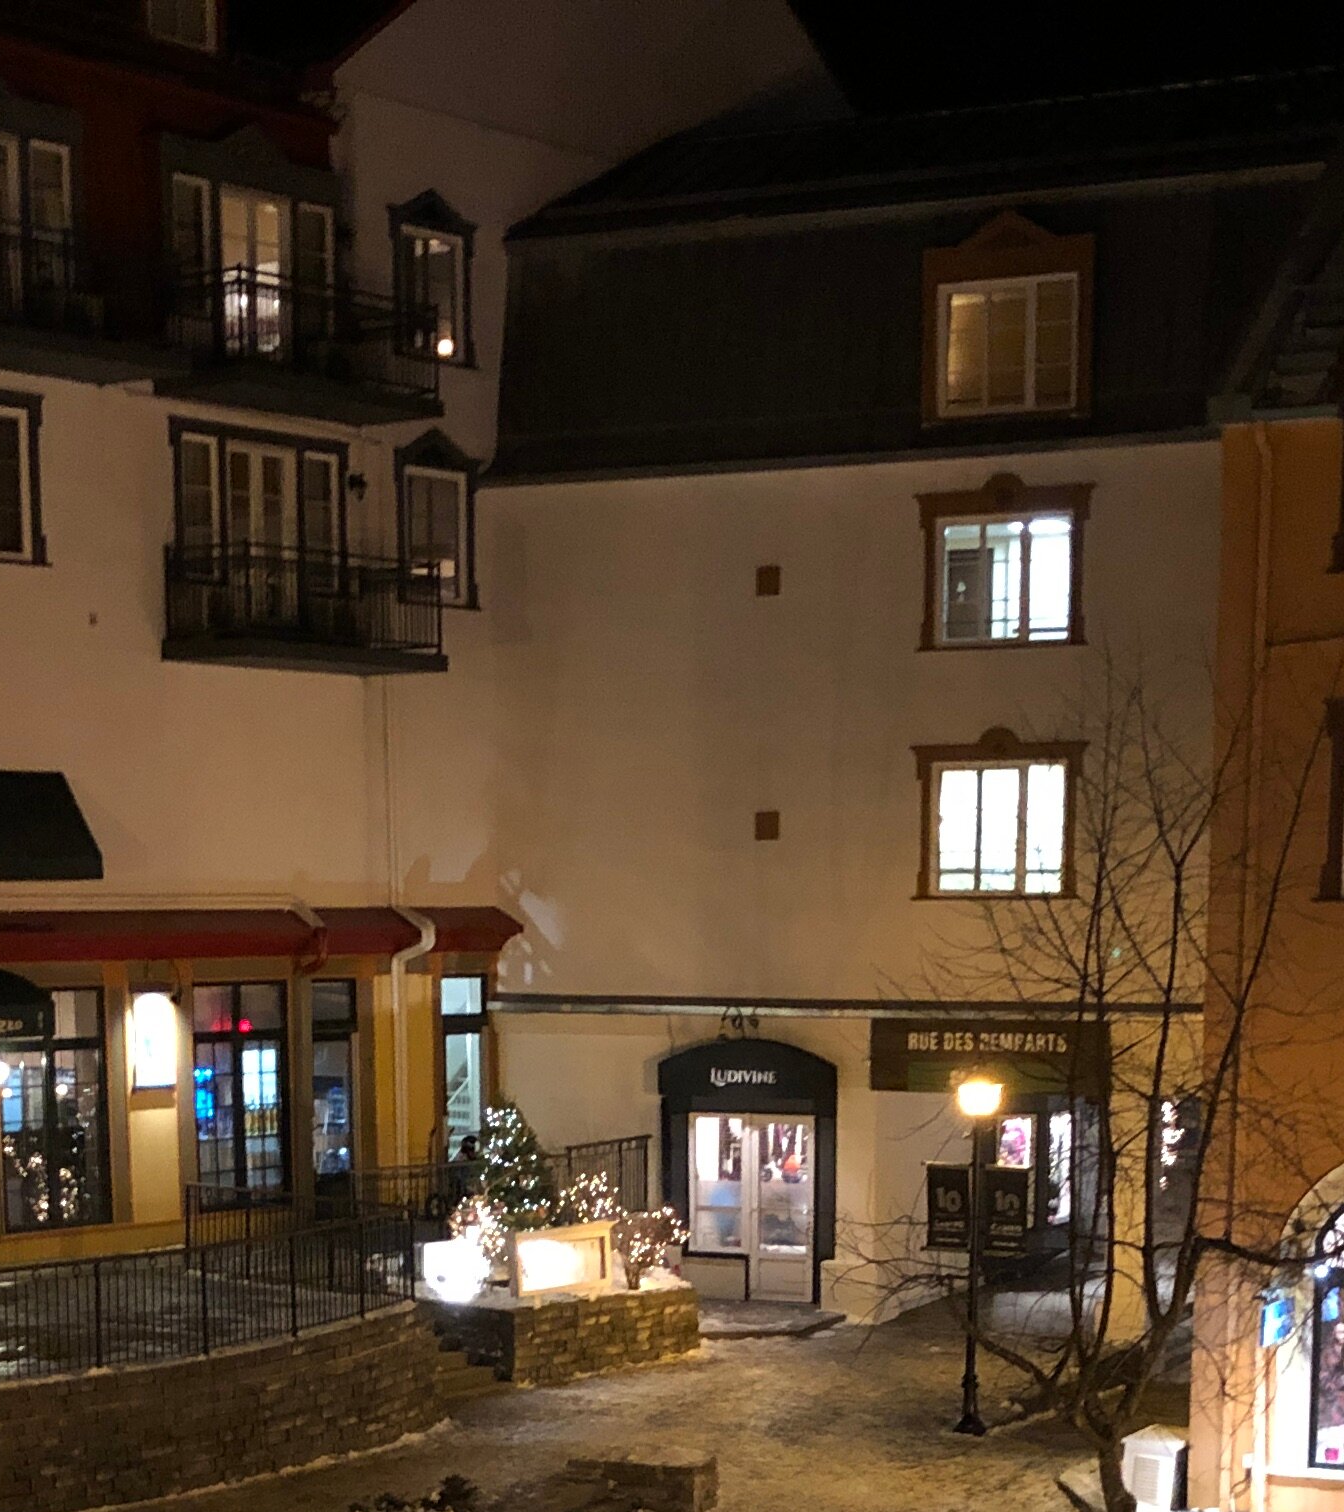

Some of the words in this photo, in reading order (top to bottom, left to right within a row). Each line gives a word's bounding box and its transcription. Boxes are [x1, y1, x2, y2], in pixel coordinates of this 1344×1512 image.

[907, 1032, 939, 1051] RUE
[943, 1032, 975, 1052] DES
[710, 1067, 777, 1087] LUDIVINE
